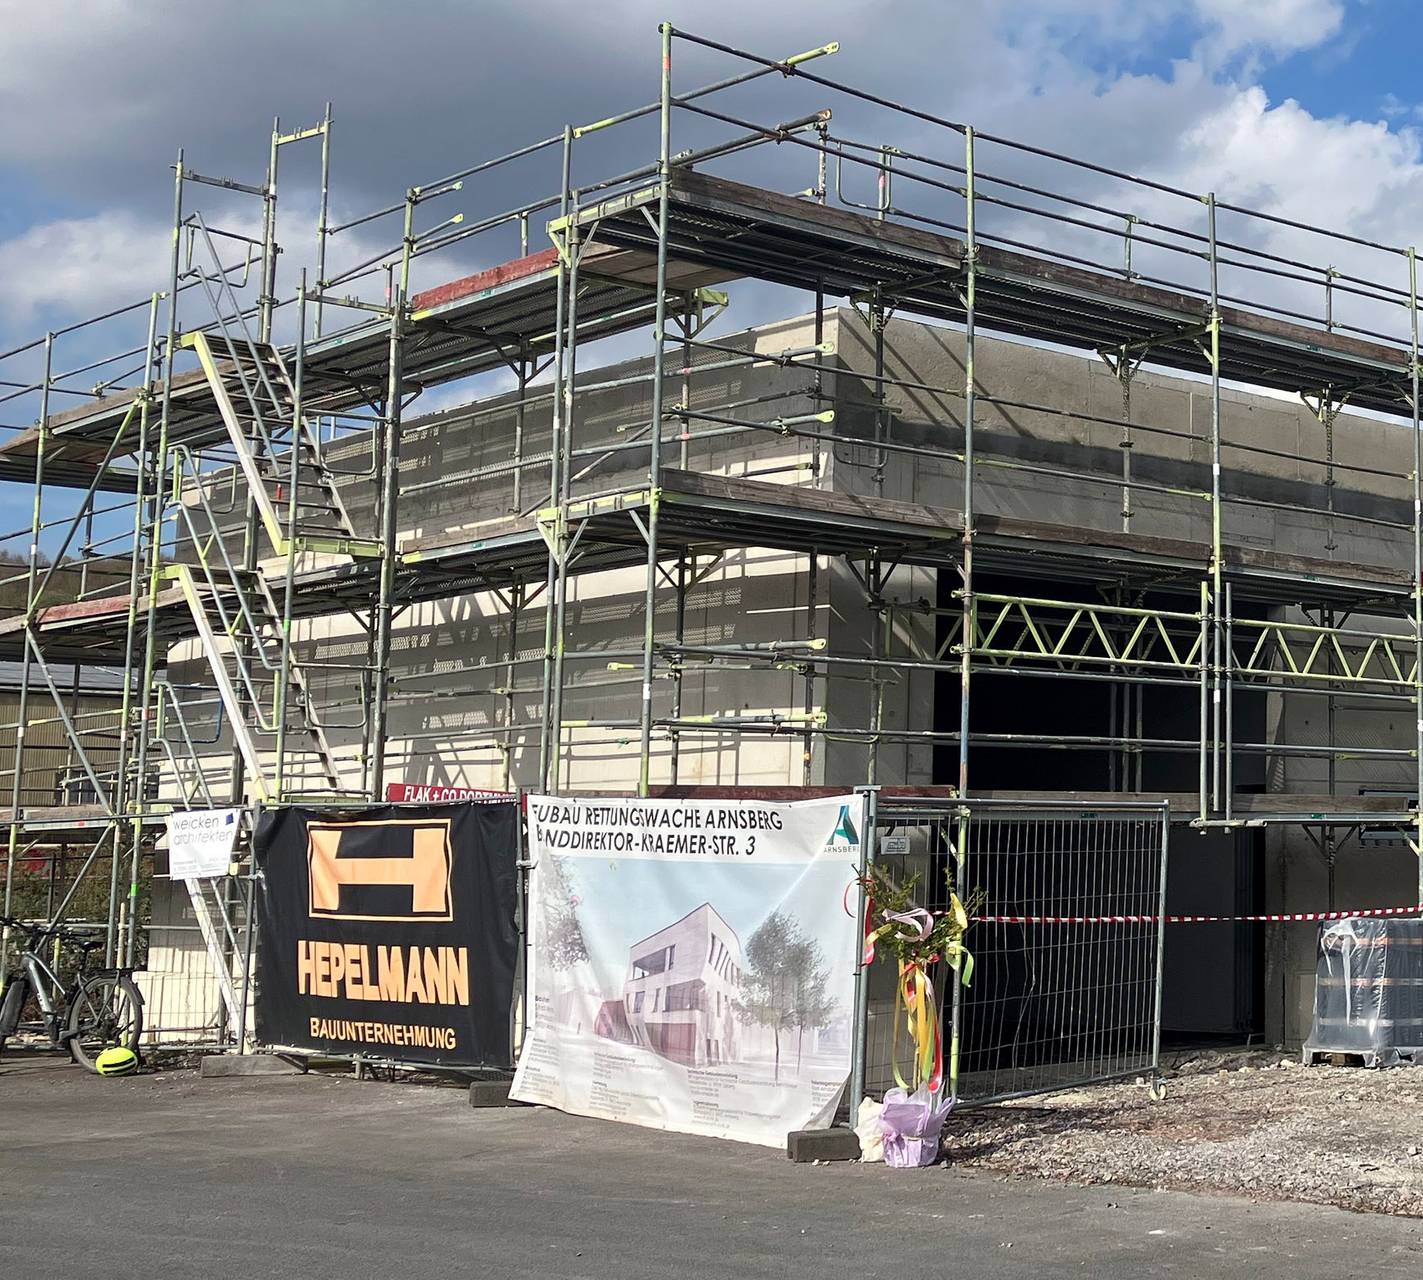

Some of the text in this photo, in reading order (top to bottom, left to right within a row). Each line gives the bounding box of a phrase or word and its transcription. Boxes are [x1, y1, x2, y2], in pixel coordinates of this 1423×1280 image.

[404, 786, 432, 801] FLAK
[441, 788, 457, 801] CO
[585, 807, 701, 829] RETTUNGSWACHE
[705, 809, 783, 830] ARNSBERG
[745, 836, 756, 855] 3
[298, 940, 470, 1006] HEPELMANN
[310, 1017, 456, 1049] BAUUNTERNEHMUNG
